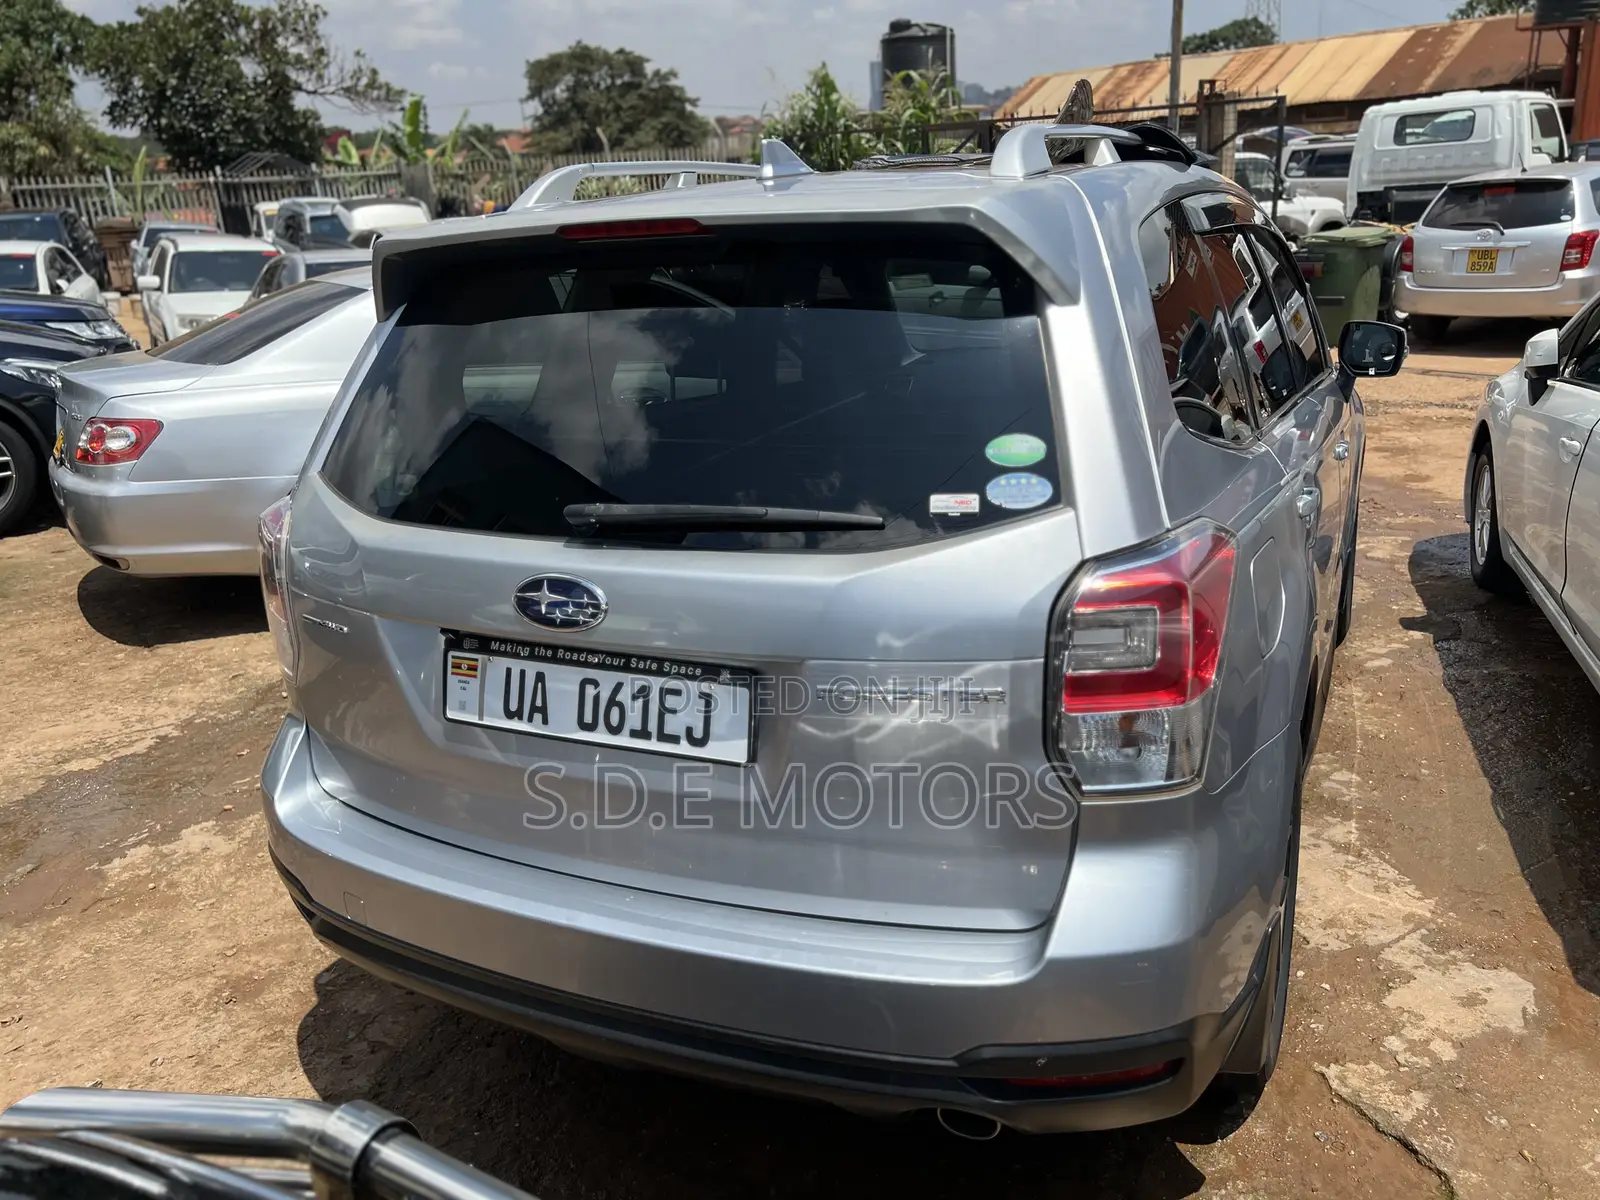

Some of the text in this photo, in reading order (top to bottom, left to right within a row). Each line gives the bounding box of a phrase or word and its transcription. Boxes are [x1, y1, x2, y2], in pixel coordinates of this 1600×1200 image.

[1476, 249, 1496, 260] UBL
[1470, 261, 1495, 272] 859A
[490, 640, 530, 656] Making
[534, 646, 553, 657] the
[599, 653, 626, 666] Your
[630, 657, 657, 670] Safe
[663, 661, 702, 676] Space
[503, 666, 549, 726] UA
